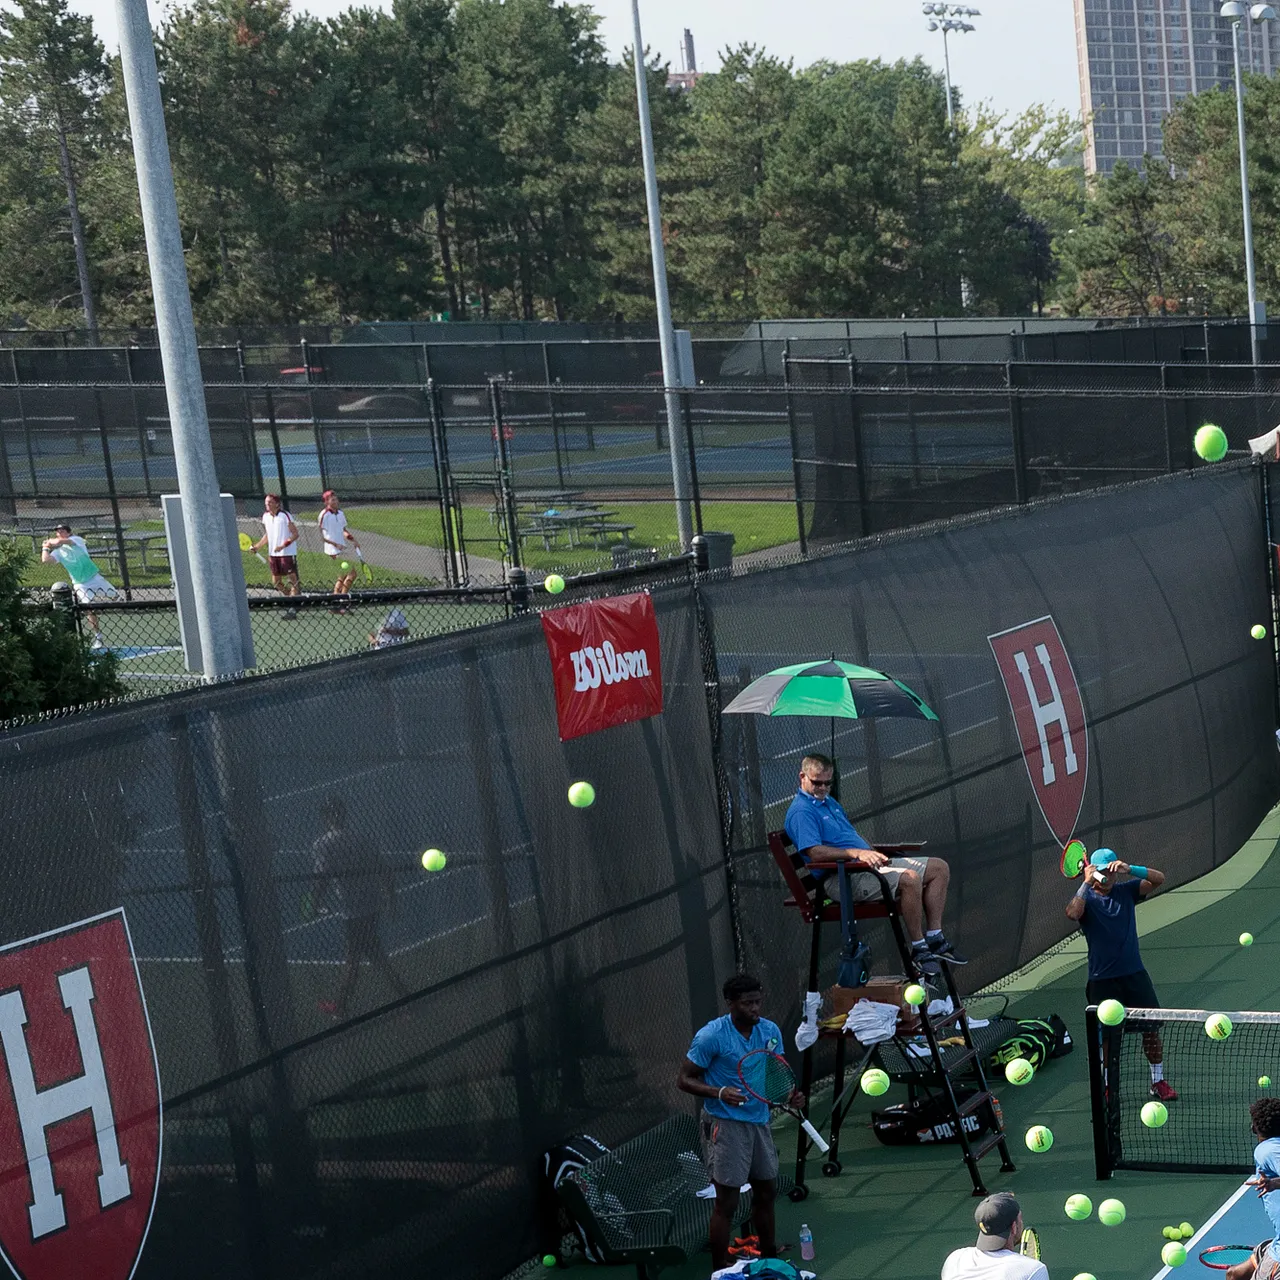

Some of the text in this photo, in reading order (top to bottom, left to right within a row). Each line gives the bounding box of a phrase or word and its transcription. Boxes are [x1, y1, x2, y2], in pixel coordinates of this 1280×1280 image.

[570, 640, 650, 692] Wilson
[1014, 645, 1078, 786] H
[0, 966, 131, 1240] H
[934, 1115, 980, 1140] PAFIC
